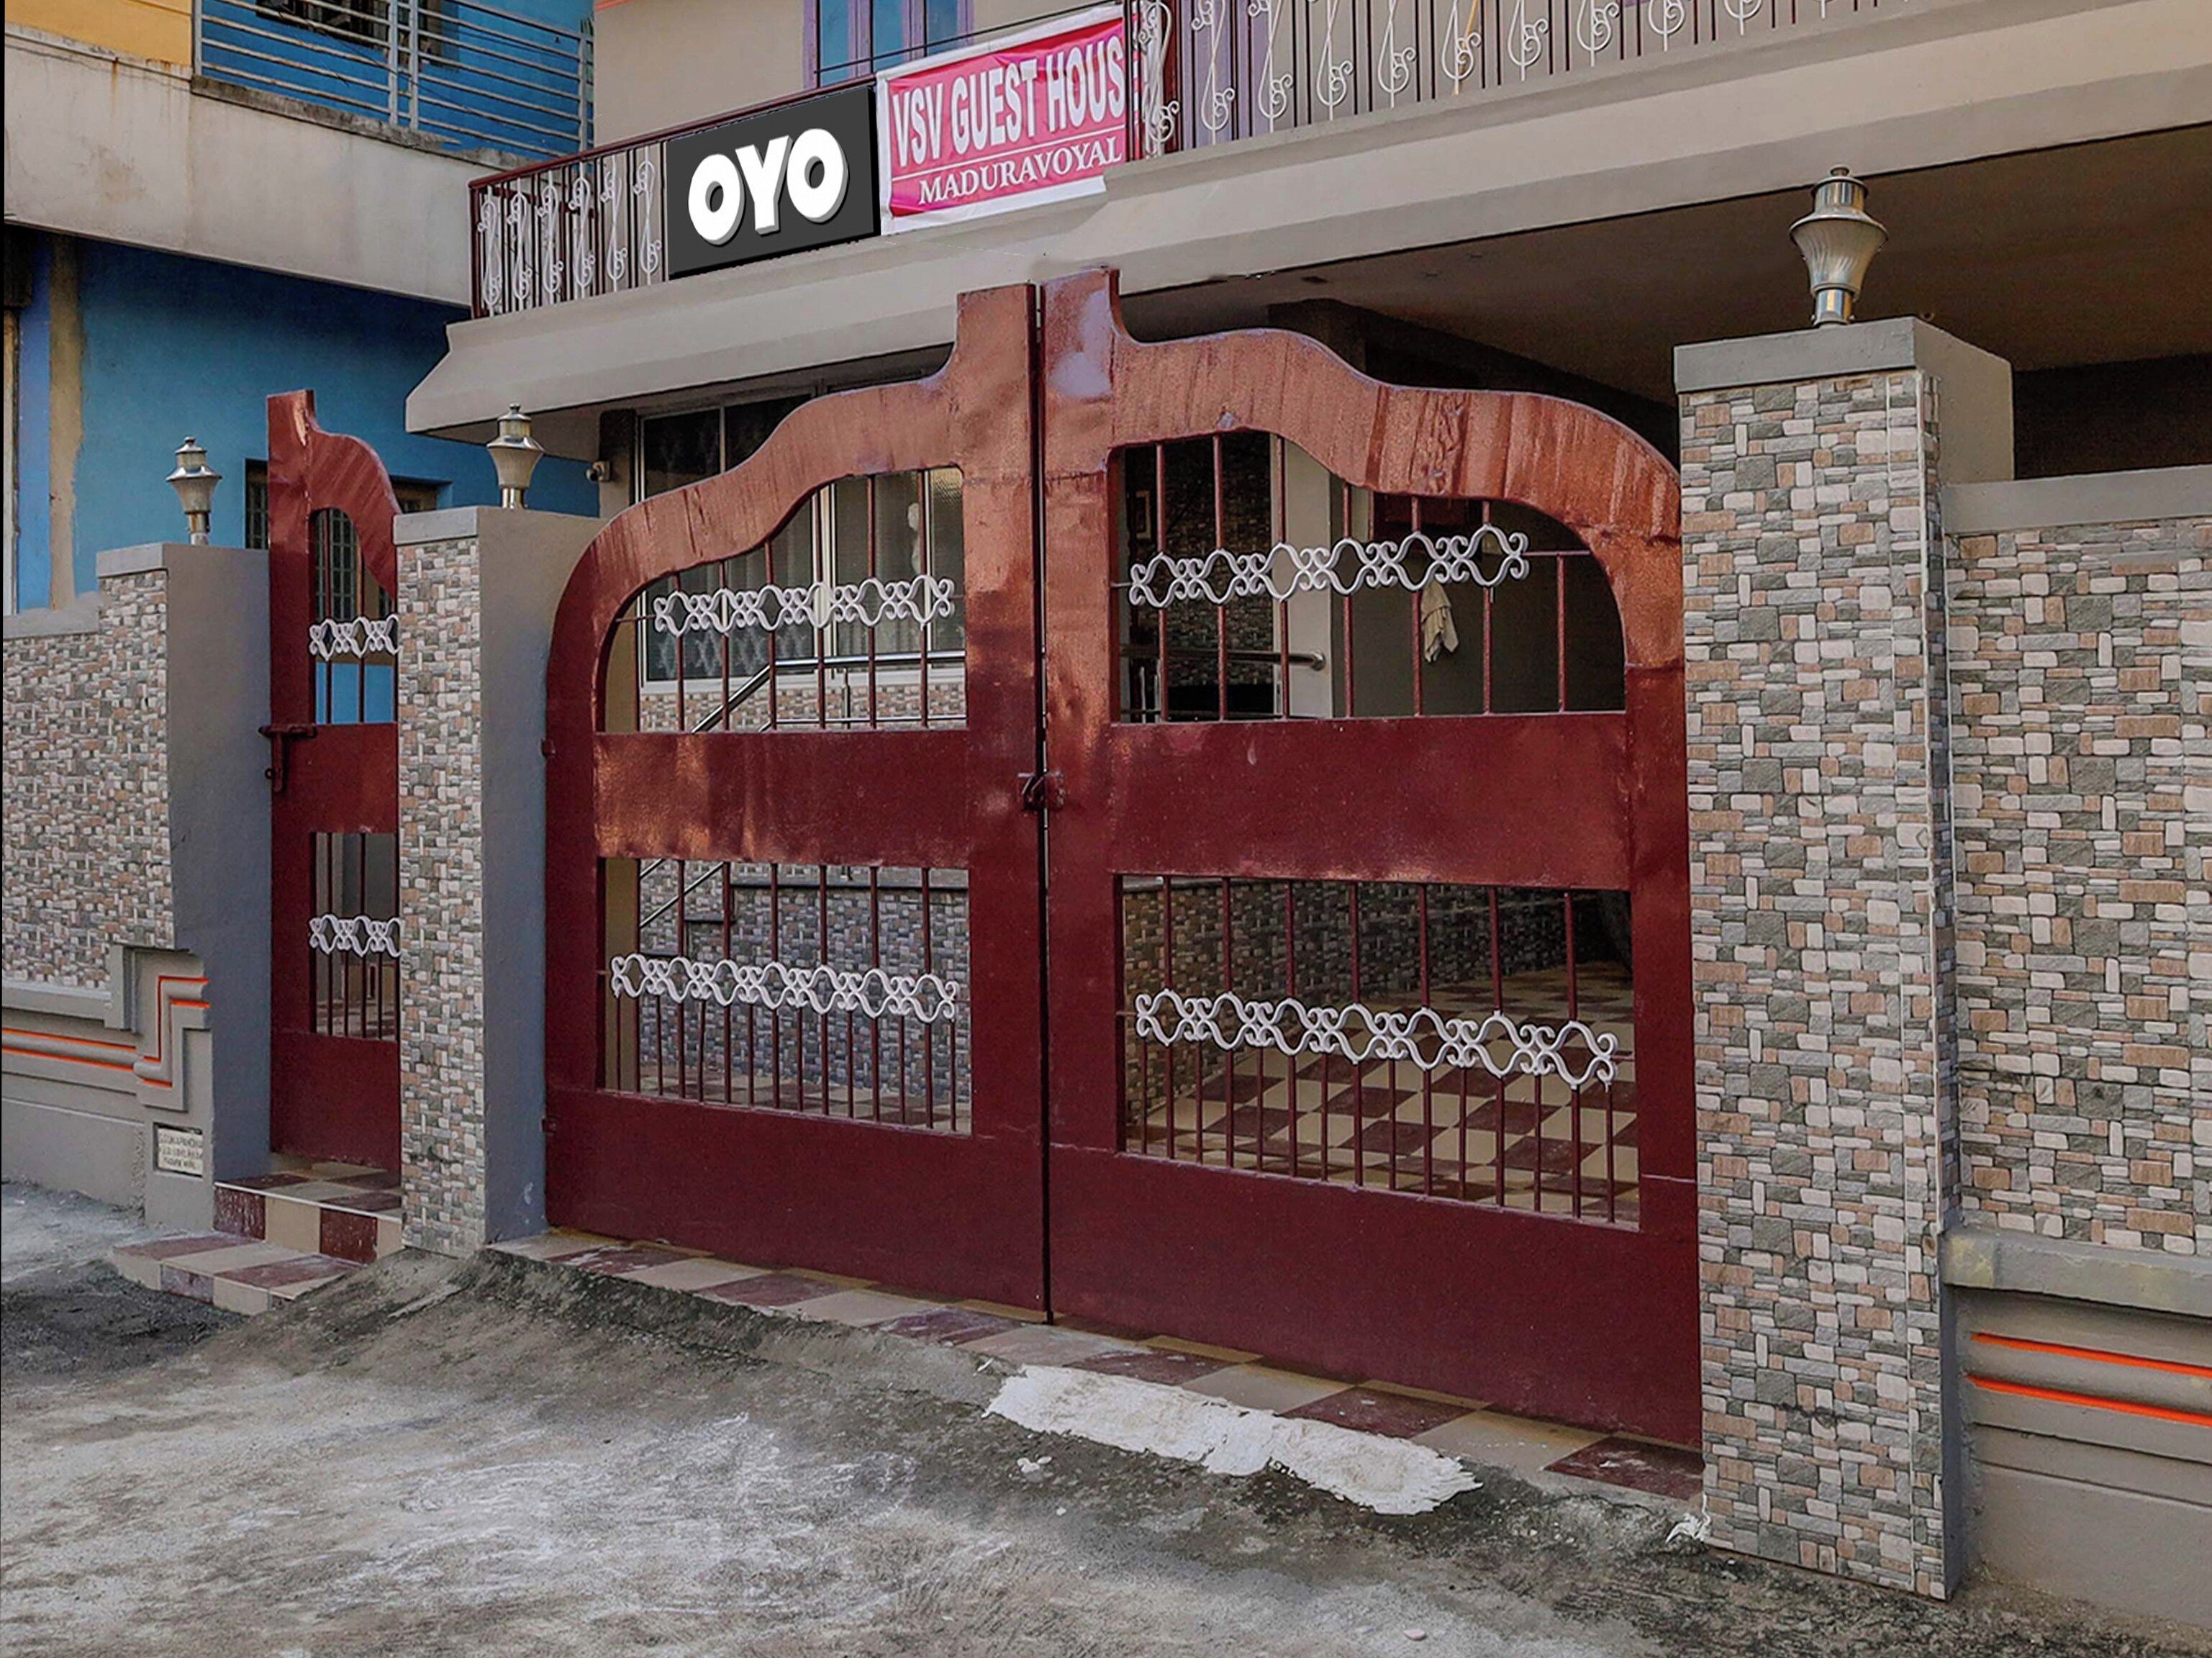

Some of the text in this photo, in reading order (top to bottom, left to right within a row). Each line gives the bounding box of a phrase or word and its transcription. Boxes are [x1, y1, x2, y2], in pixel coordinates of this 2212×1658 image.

[892, 34, 1136, 167] VSV GUEST HOUS
[688, 128, 849, 245] OYO
[918, 137, 1122, 205] MADURAVOYAL
